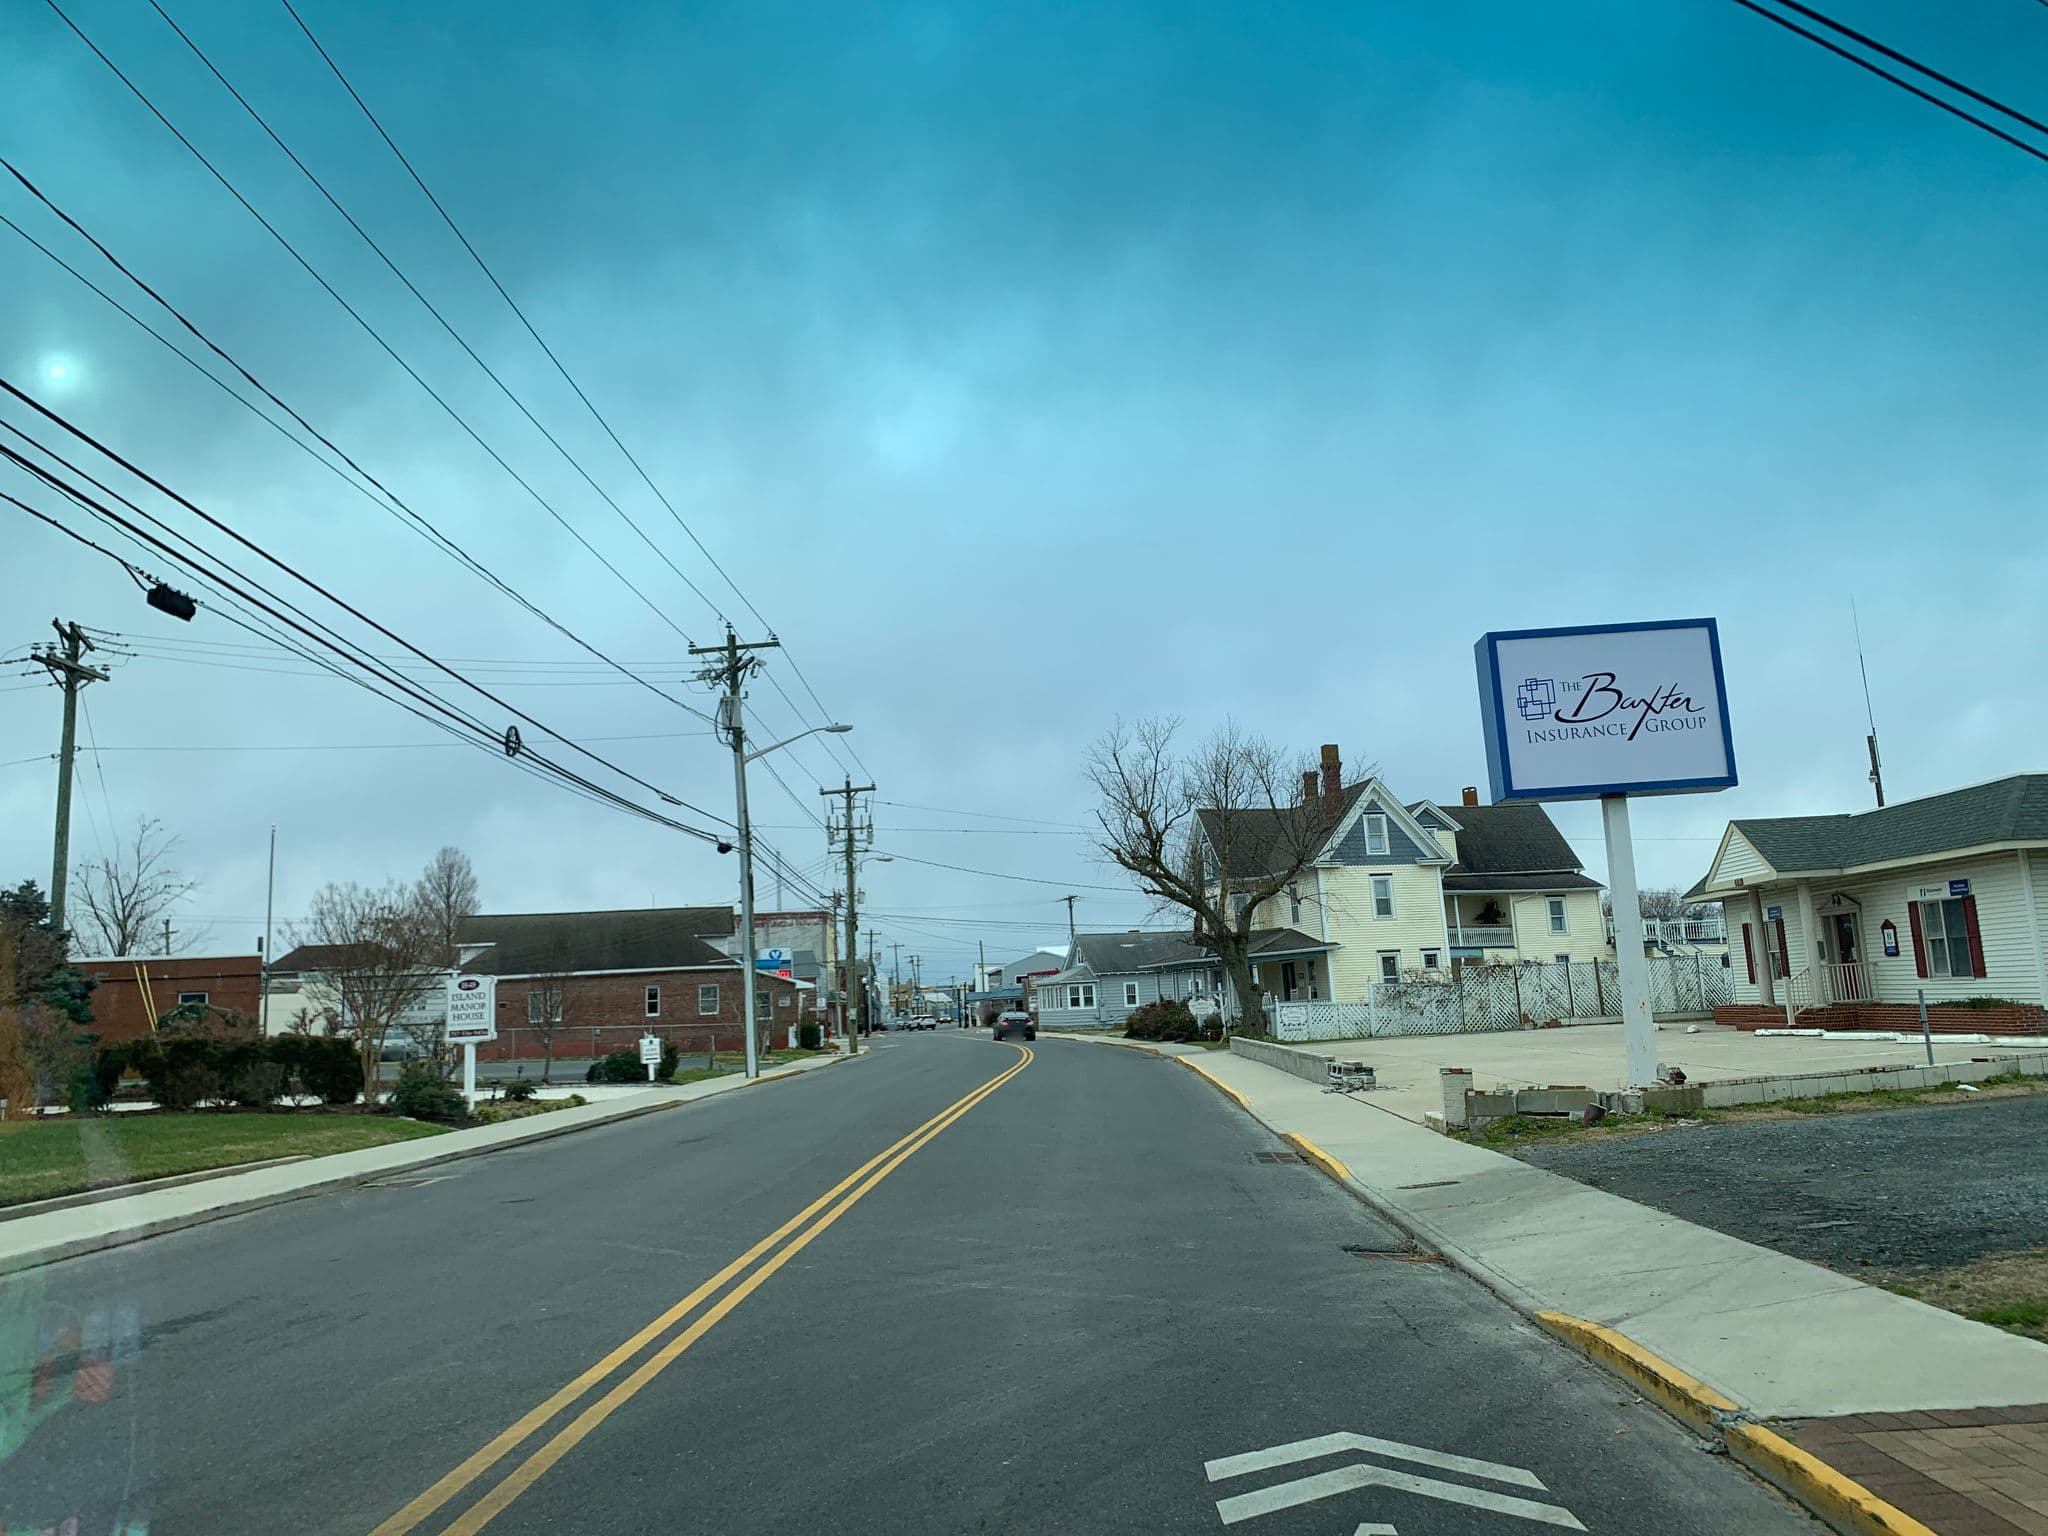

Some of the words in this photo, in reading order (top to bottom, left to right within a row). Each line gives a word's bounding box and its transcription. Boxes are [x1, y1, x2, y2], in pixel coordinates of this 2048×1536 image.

[1561, 681, 1582, 693] THE
[1555, 672, 1705, 741] Baxter
[1527, 723, 1628, 744] INSURANCE
[1645, 715, 1706, 733] GROUP
[451, 992, 486, 1001] ISLAND
[450, 1003, 487, 1012] MANOR
[452, 1012, 486, 1022] HOUSE
